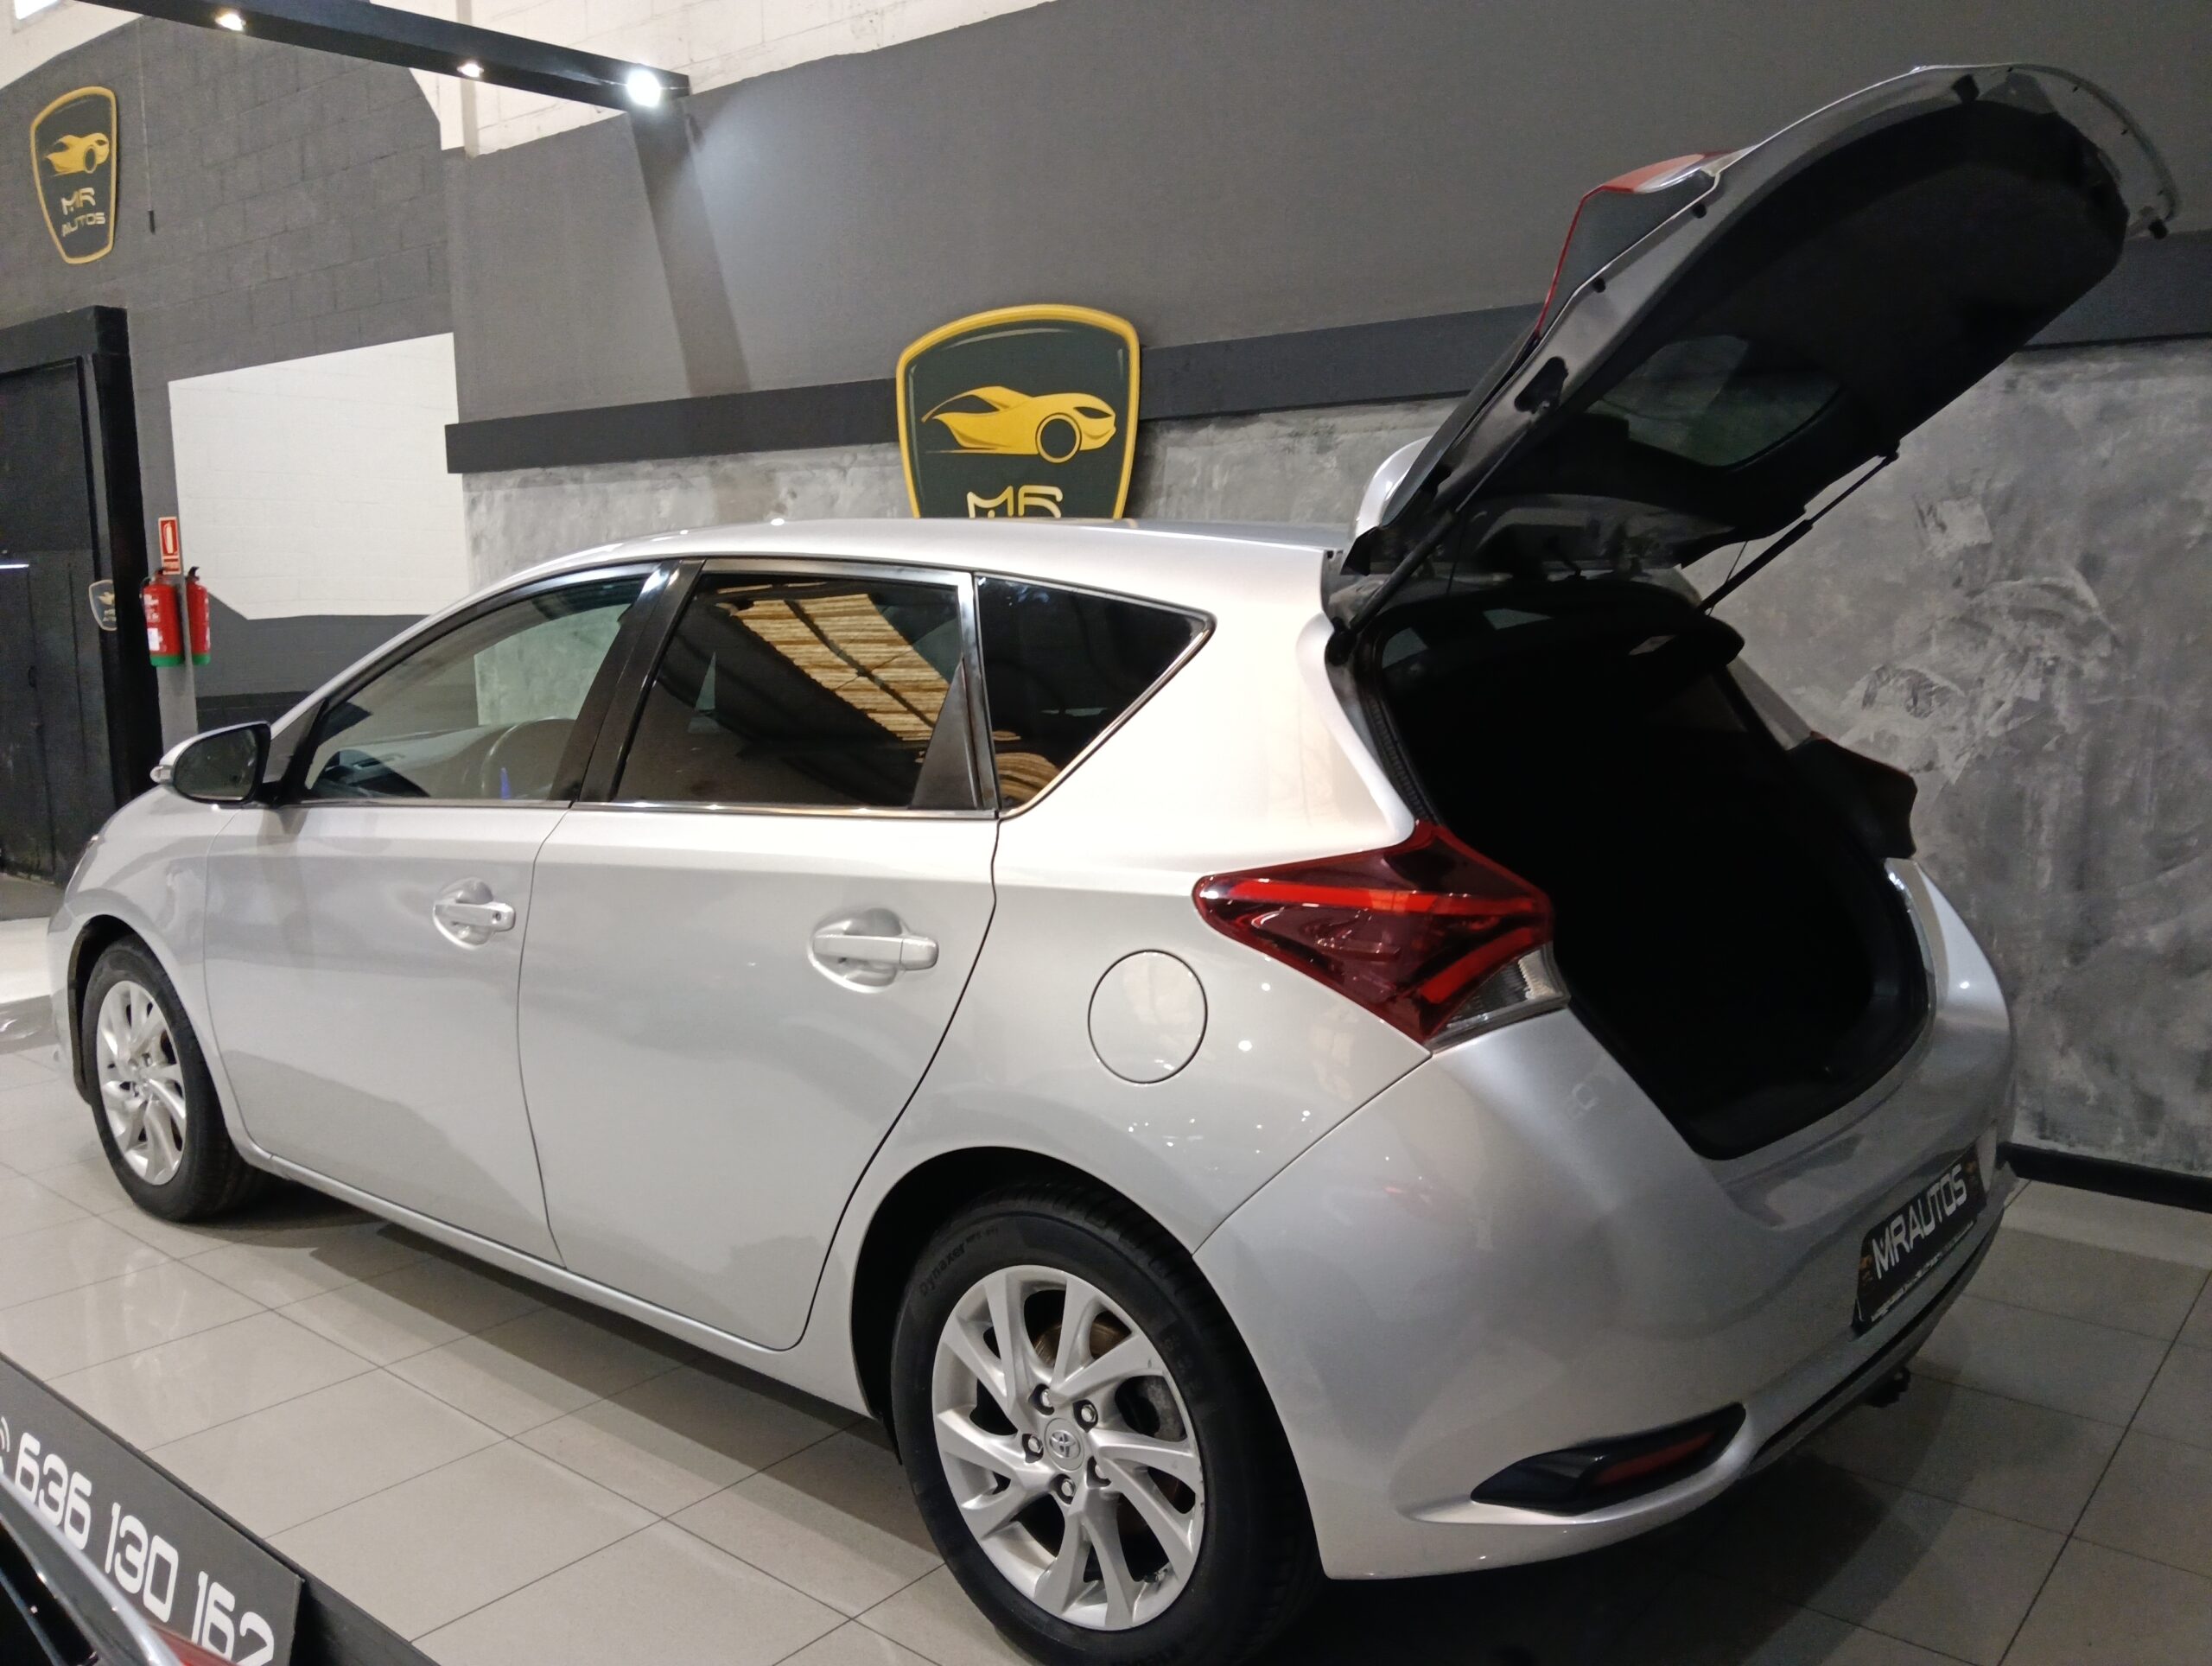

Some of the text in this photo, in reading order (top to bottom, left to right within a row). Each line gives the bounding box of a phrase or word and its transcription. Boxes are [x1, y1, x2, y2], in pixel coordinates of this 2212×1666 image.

[61, 187, 96, 215] MR
[61, 212, 105, 238] AUTOS
[967, 485, 1064, 518] MR
[1872, 1163, 1967, 1281] MRAUTOS
[15, 1432, 275, 1666] 636 130 162
